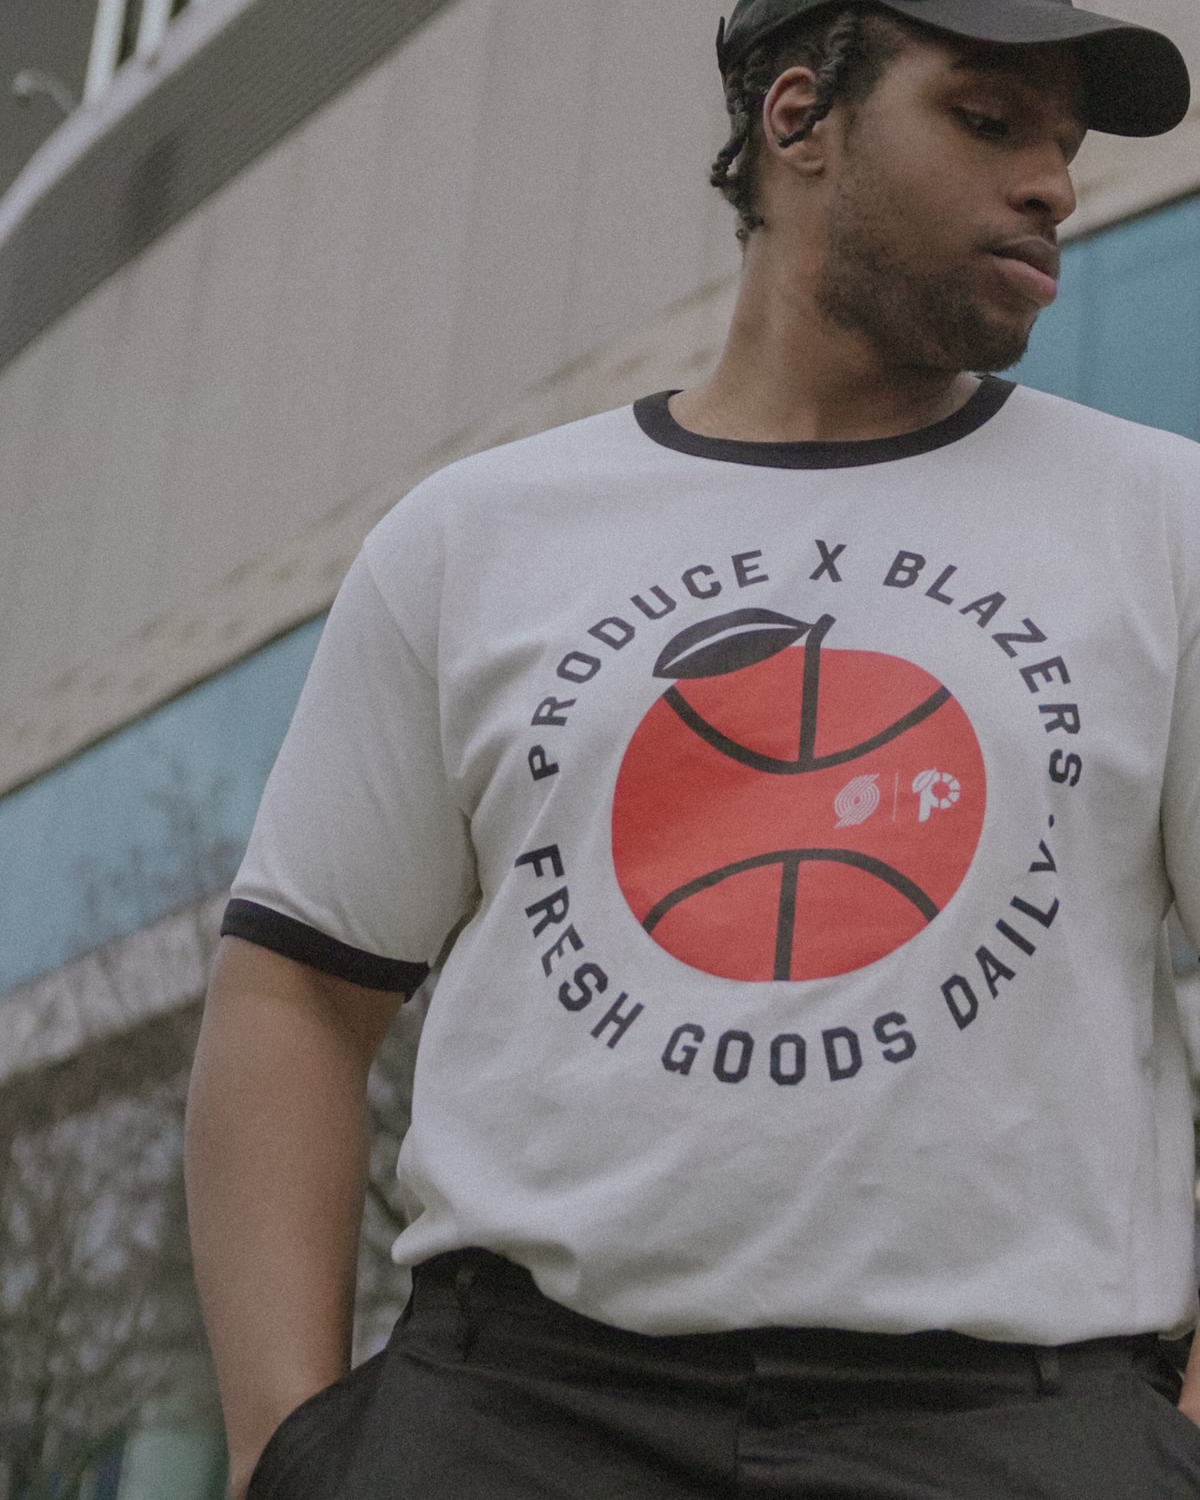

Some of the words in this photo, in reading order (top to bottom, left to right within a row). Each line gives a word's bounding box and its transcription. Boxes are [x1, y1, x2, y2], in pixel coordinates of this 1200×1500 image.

[527, 550, 769, 781] PRODUCE
[809, 540, 847, 583] X
[882, 549, 1083, 788] BLAZERS
[514, 843, 645, 1050] FRESH
[660, 1010, 917, 1086] GOODS
[939, 839, 1060, 1030] DAILY
